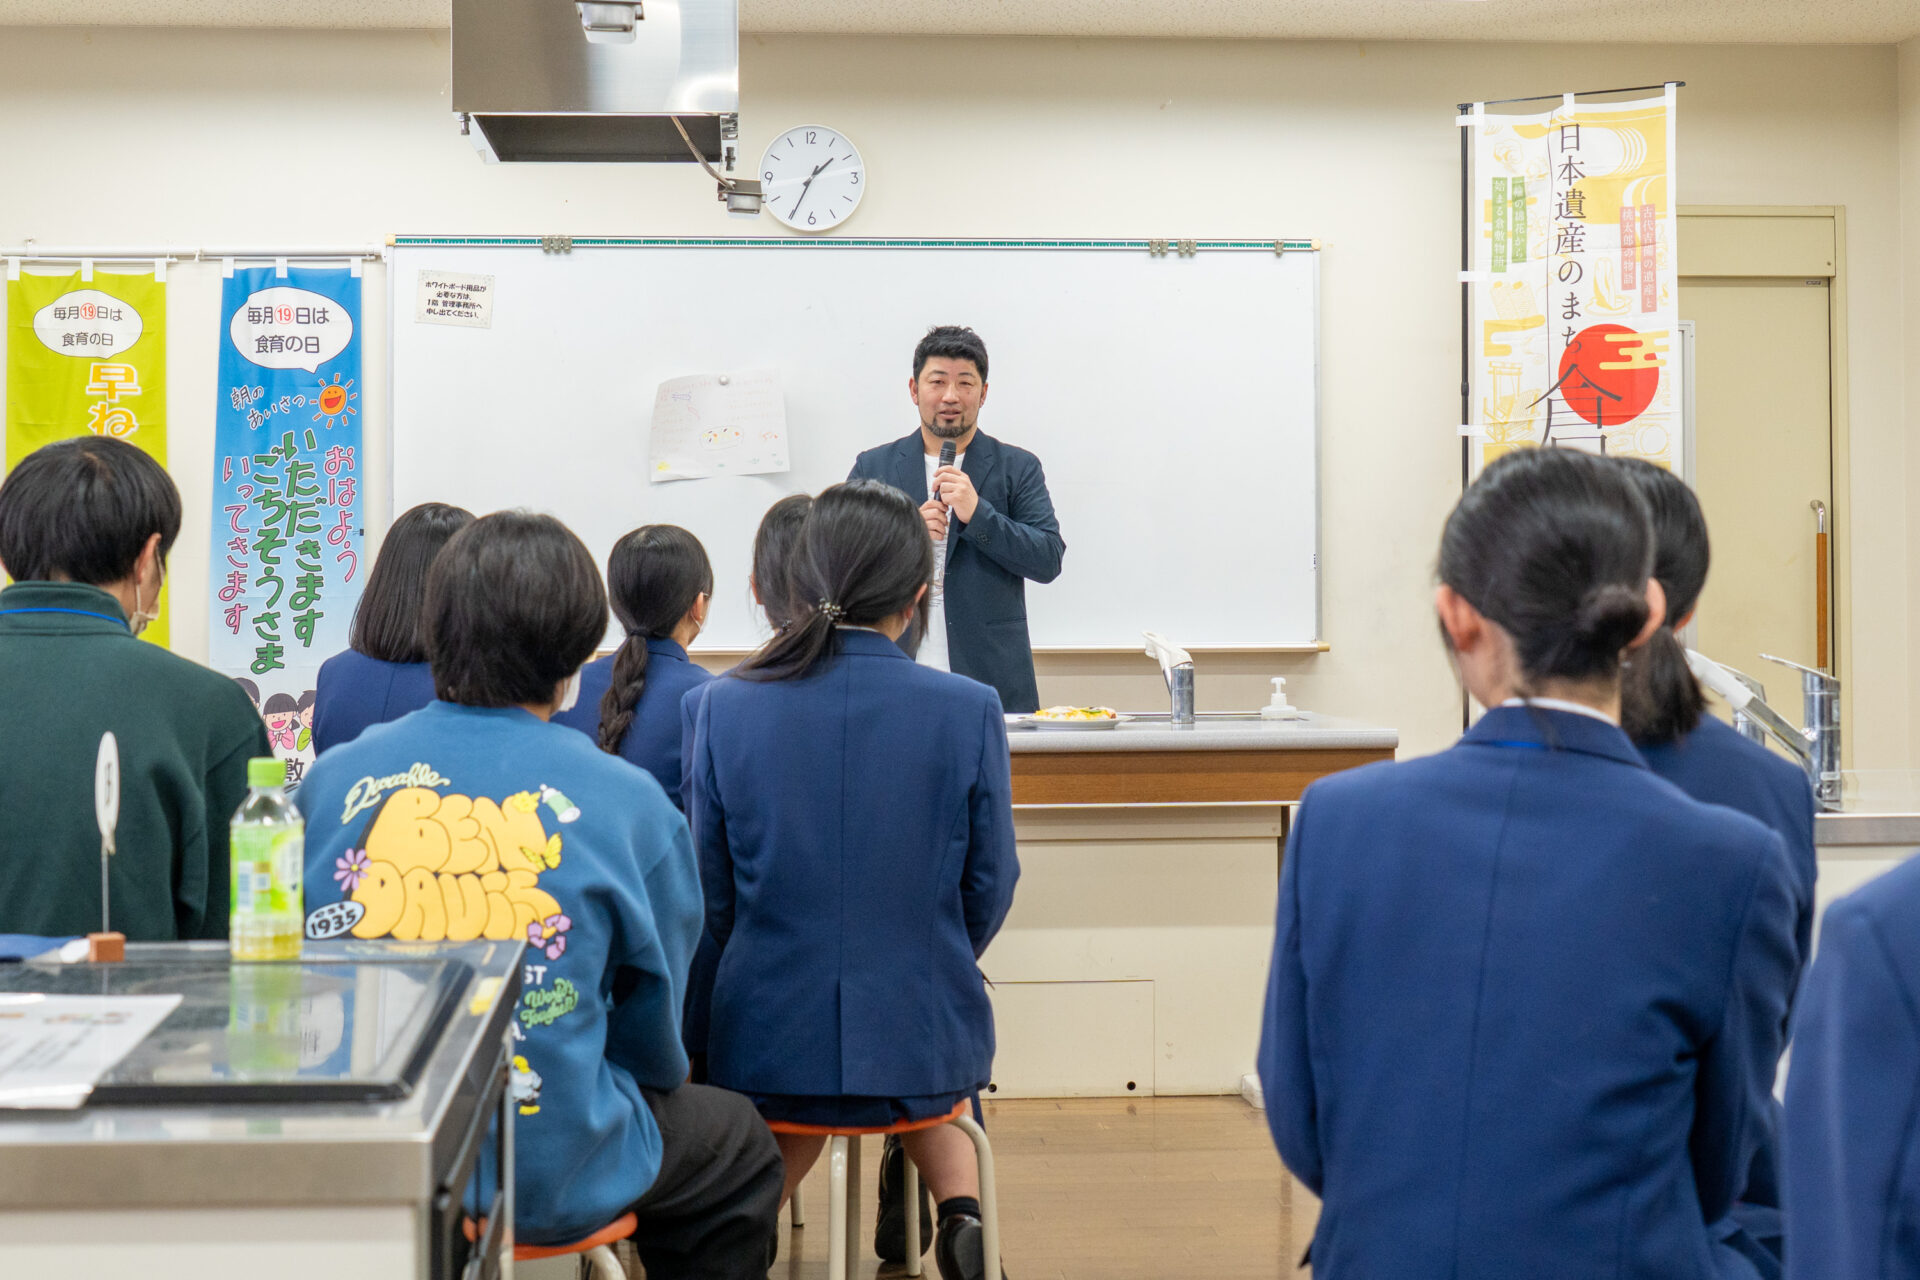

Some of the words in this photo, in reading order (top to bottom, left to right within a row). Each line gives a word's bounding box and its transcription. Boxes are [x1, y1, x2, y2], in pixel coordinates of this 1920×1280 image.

[806, 131, 817, 145] 12
[764, 171, 774, 186] 9
[850, 171, 859, 185] 3
[807, 211, 817, 225] 6
[1554, 123, 1586, 354] 日本遺産のまち
[1622, 208, 1634, 285] 桃太郎の物語
[62, 332, 114, 347] 食育の日
[255, 335, 320, 354] 食育の日
[231, 385, 265, 411] 朝の
[247, 395, 305, 430] あいさつ
[324, 446, 358, 584] おはよう
[218, 457, 253, 635] いってきます
[283, 429, 327, 648] いただきます
[250, 446, 288, 675] ごちそうさま
[364, 786, 548, 876] BEN
[311, 908, 357, 937] 1935
